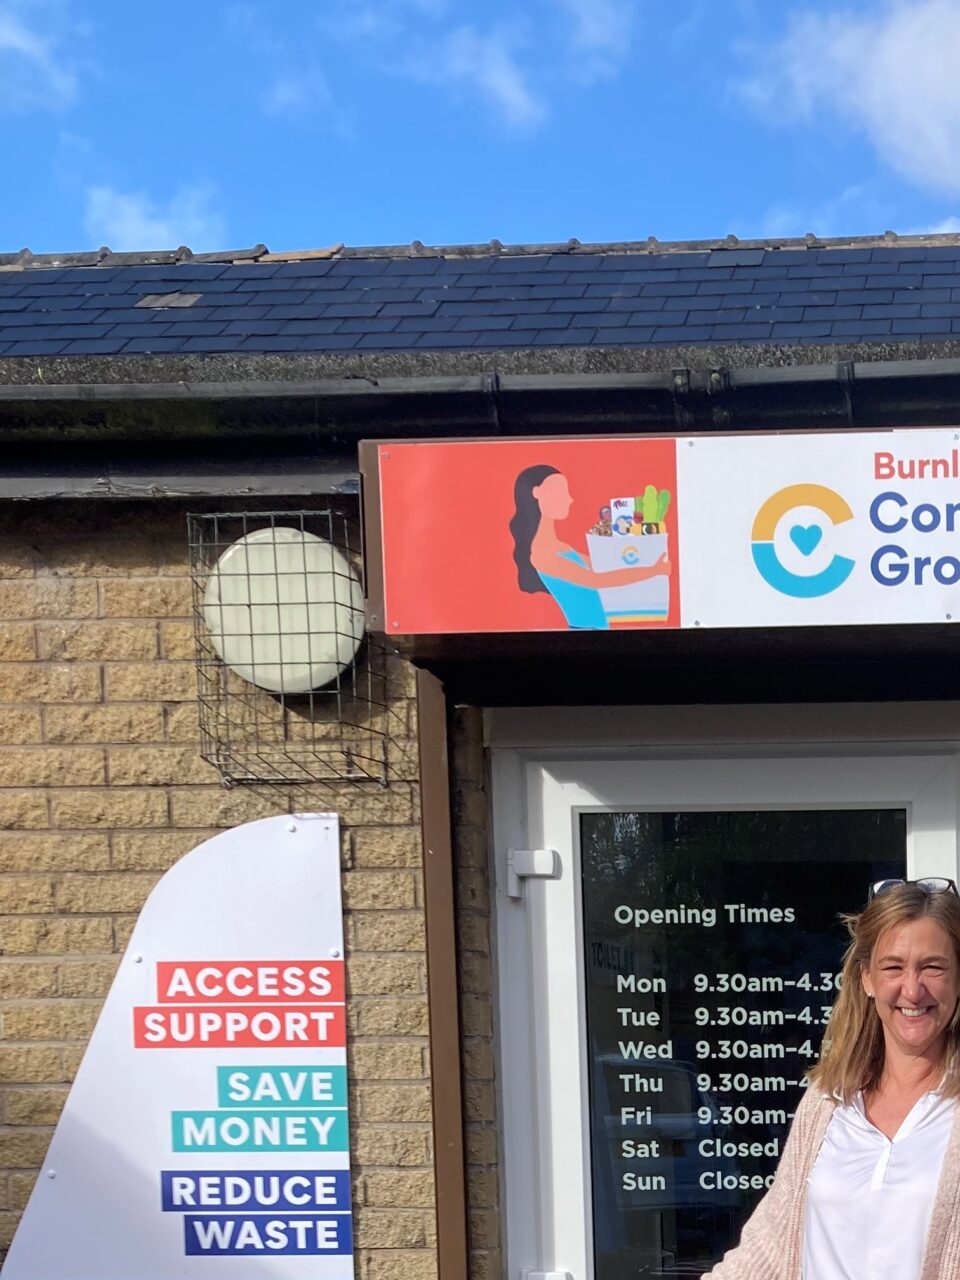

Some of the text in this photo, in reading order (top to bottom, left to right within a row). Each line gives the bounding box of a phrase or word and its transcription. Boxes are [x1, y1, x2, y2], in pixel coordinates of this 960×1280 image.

[615, 904, 795, 927] Opening Times
[167, 967, 331, 996] ACCESS
[617, 973, 843, 992] Mon 9.30am-4.30
[144, 1012, 334, 1042] SUPPORT
[617, 1007, 832, 1026] Tue 9.30am-4.3
[619, 1041, 673, 1059] Wed
[228, 1072, 333, 1101] SAVE
[619, 1074, 663, 1092] Thu
[621, 1107, 795, 1125] Fri 9.30am-
[183, 1117, 336, 1146] MONEY
[622, 1139, 778, 1158] Sat Closed
[172, 1176, 337, 1206] REDUCE
[623, 1173, 665, 1190] Sun
[193, 1220, 339, 1249] WASTE
